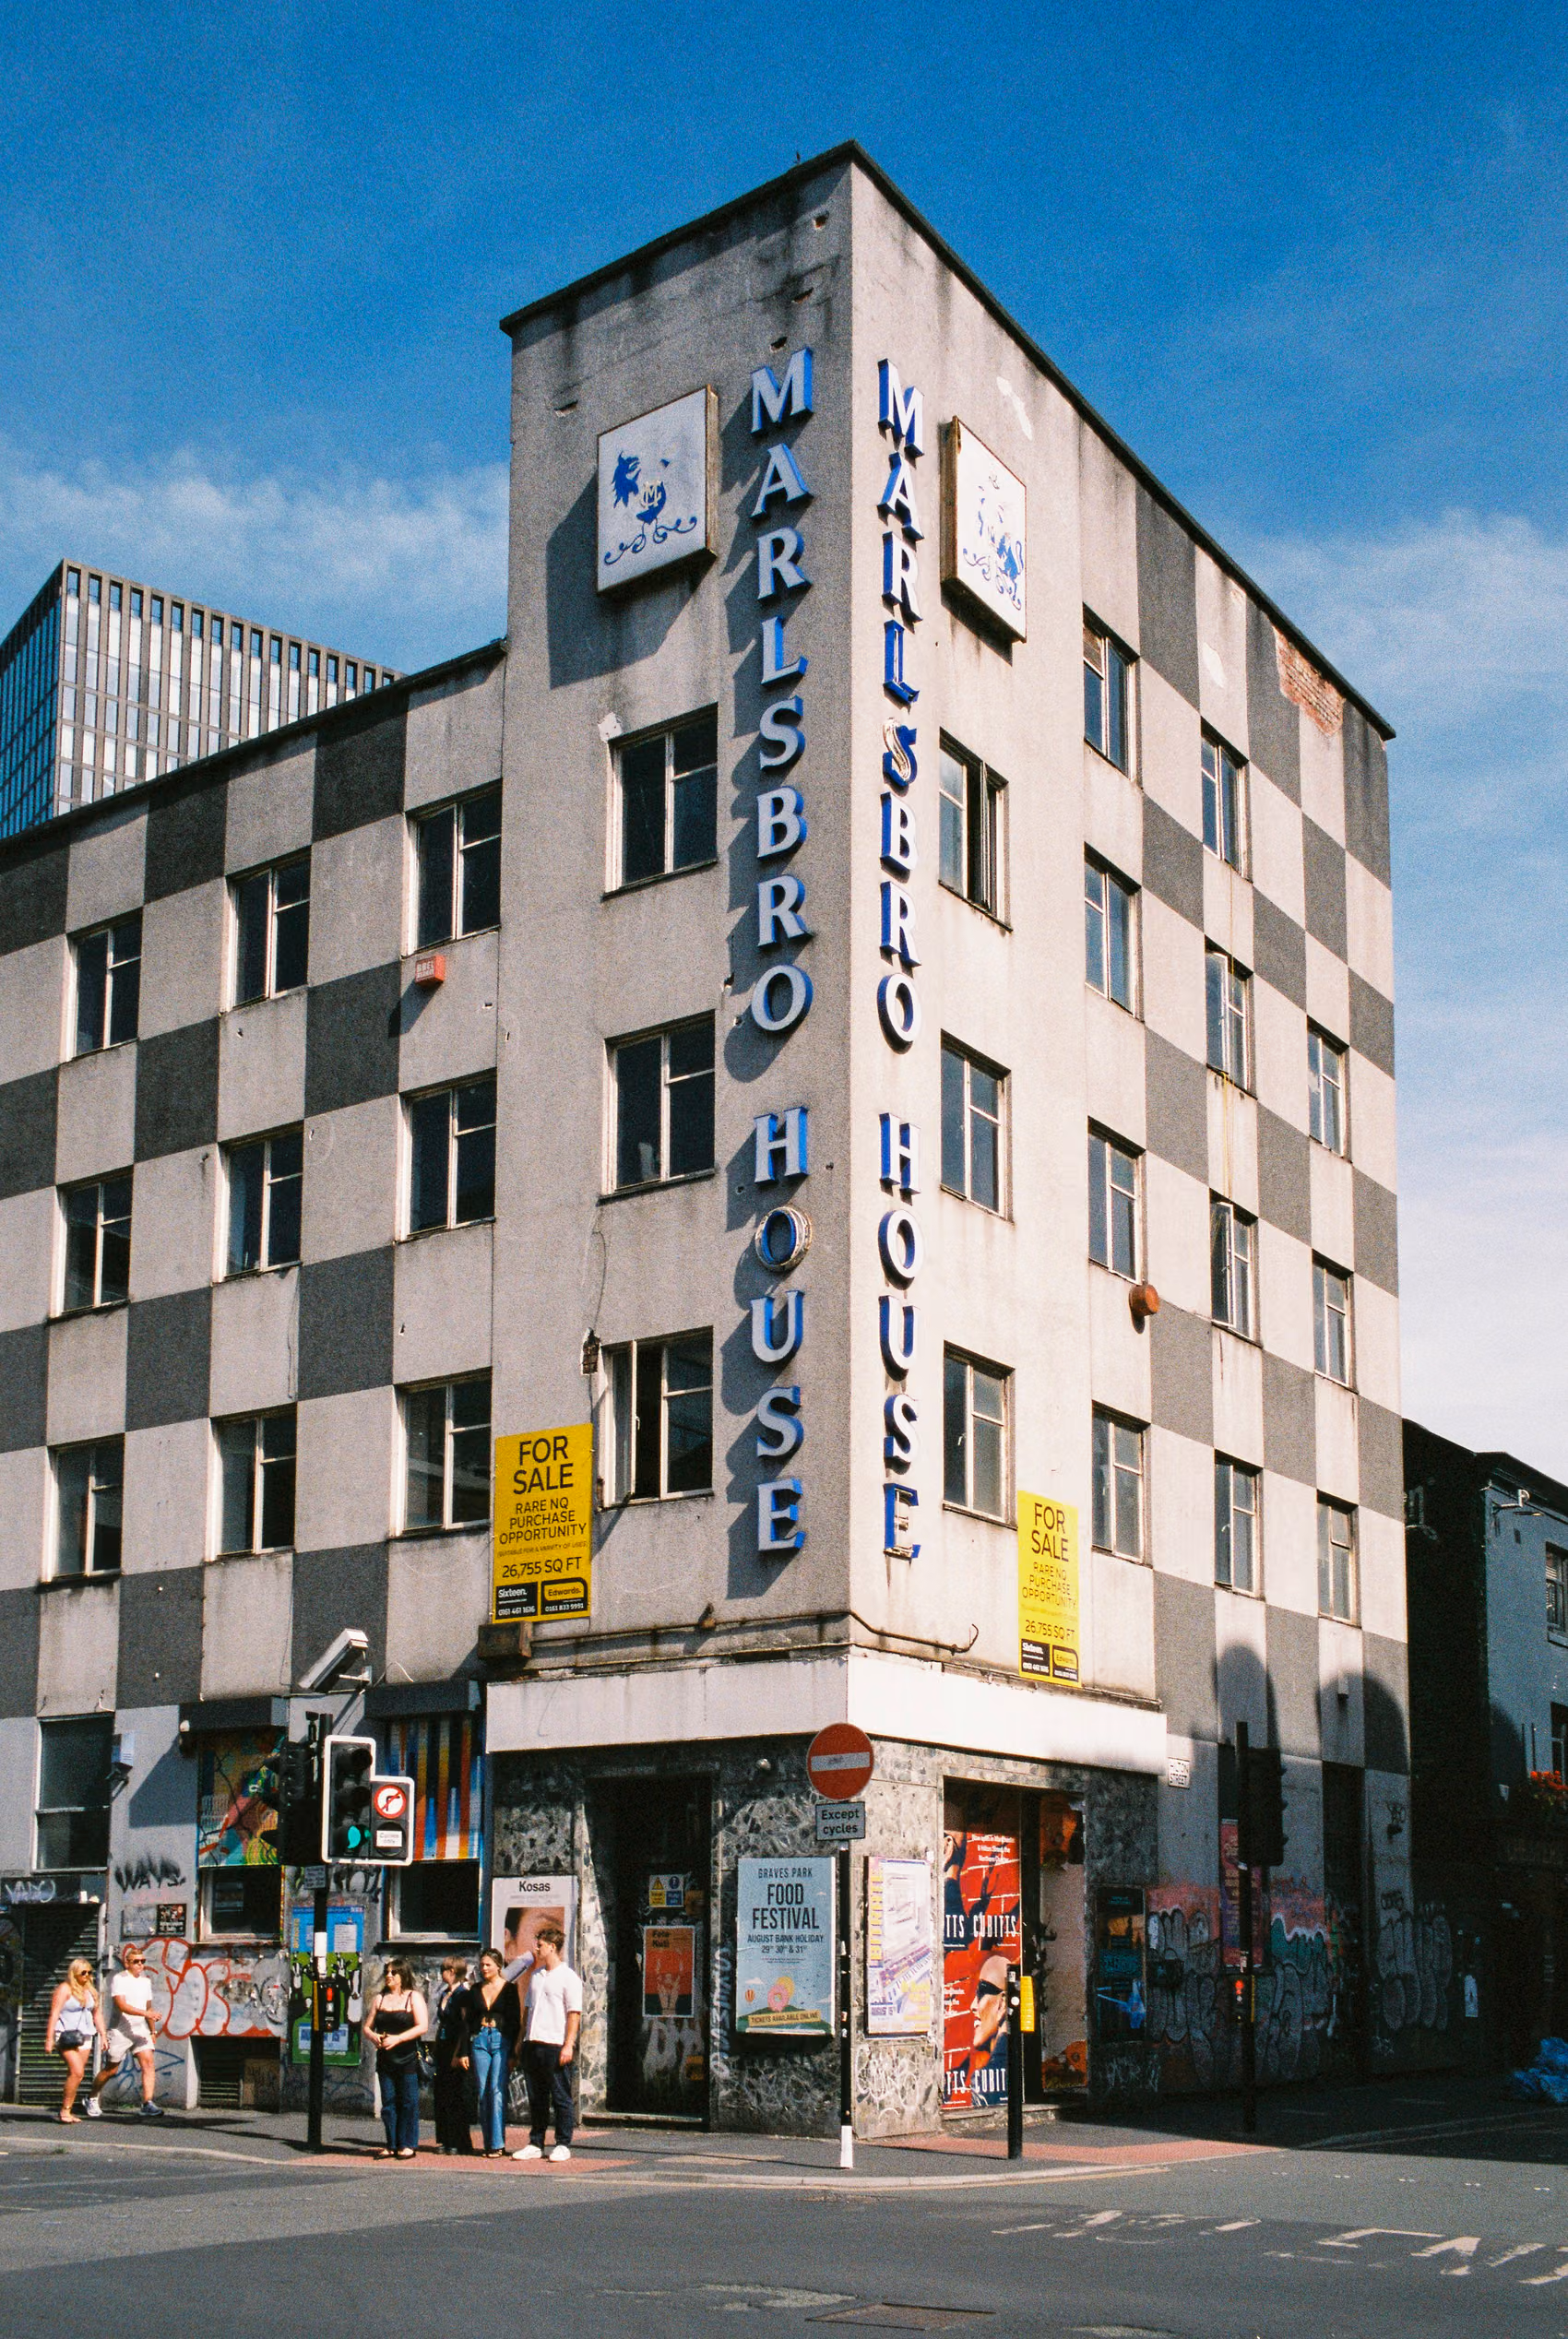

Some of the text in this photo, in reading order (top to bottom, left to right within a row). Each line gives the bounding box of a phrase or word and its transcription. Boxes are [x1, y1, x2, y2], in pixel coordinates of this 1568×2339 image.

[750, 347, 814, 1551] MARLSBRO HOUSE
[878, 1112, 921, 1559] HOUSE
[519, 1435, 568, 1466] FOR
[513, 1463, 574, 1494] SALE
[516, 1497, 568, 1514] RARE NQ
[509, 1511, 576, 1529] PURCHASE
[1033, 1502, 1065, 1534] FOR
[499, 1523, 587, 1544] OPPORTUNITY
[1031, 1530, 1069, 1562] SALE
[503, 1557, 582, 1579] 26,755 SQ FT
[1033, 1561, 1054, 1578] RARE
[548, 1587, 581, 1597] Edwards.
[1029, 1574, 1071, 1596] PURCHASE
[1022, 1586, 1077, 1609] OPPORTUNITY
[1051, 1625, 1065, 1642] SQ
[1065, 1629, 1075, 1643] FT
[821, 1809, 860, 1821] Except
[823, 1823, 858, 1835] cycles
[758, 1867, 813, 1879] GRAVES PARK
[518, 1881, 551, 1892] Kosas
[766, 1882, 804, 1906] FOOD
[752, 1906, 820, 1929] FESTIVAL
[973, 1913, 1016, 1938] CUBITTS
[747, 1933, 824, 1943] AUGUST BANK HOLIDAY
[788, 1945, 794, 1954] &
[751, 2011, 820, 2024] TICKETS AVAILABLE ONLINE
